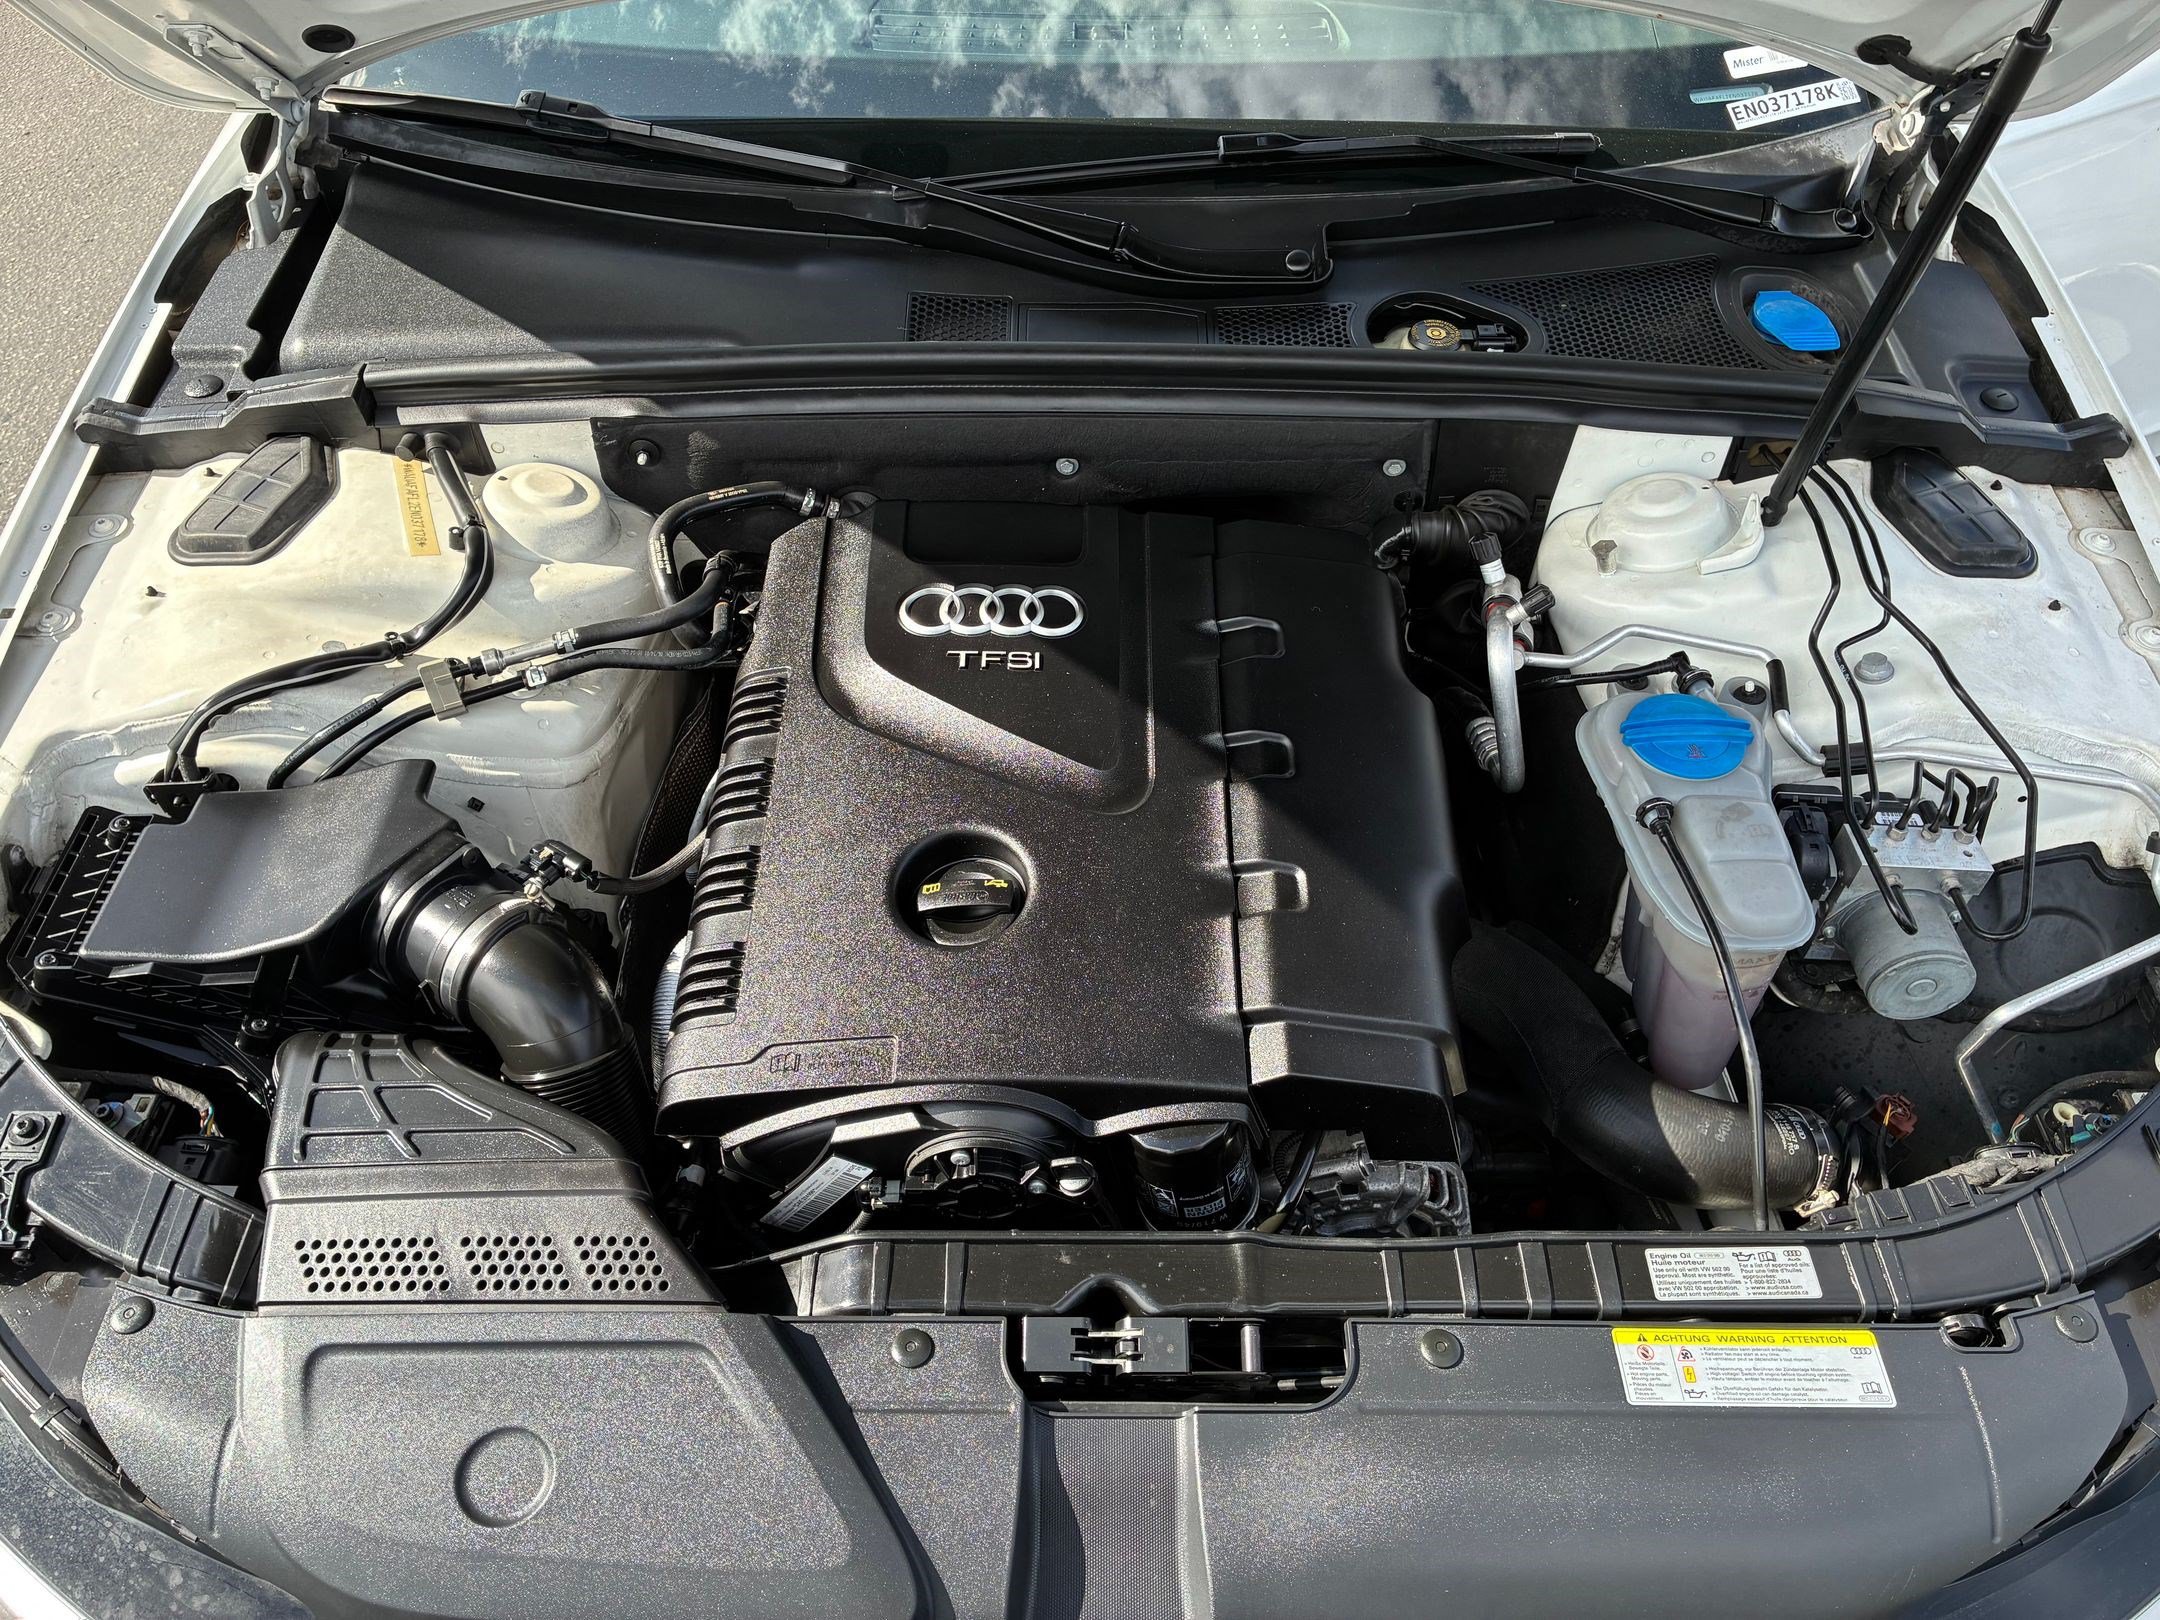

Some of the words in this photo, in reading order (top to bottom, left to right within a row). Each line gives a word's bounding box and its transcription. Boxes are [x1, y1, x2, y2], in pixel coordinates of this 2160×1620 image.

[1733, 57, 1764, 69] Mister
[1731, 83, 1840, 121] EN037178K
[946, 650, 1041, 671] TFSI
[1653, 1335, 1710, 1343] ACHTUNG
[1717, 1335, 1775, 1343] WARNING
[1782, 1336, 1847, 1344] ATTENTION
